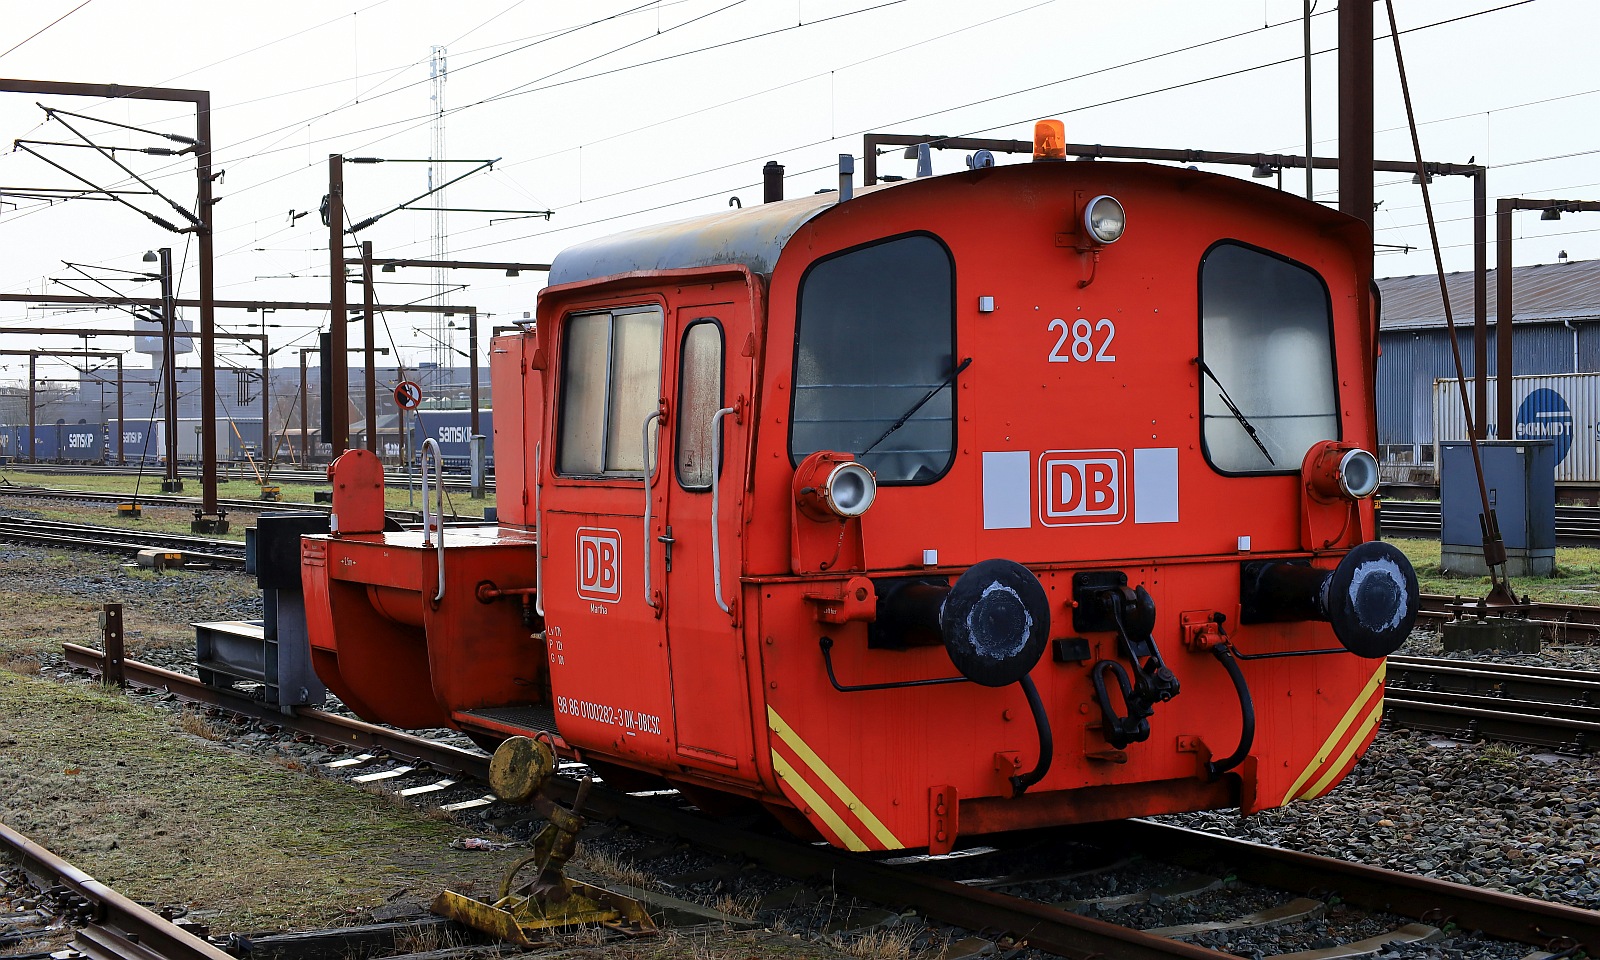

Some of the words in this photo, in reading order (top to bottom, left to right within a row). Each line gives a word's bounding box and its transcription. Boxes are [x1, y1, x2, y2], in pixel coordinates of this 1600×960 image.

[1047, 318, 1116, 363] 282
[1516, 422, 1572, 436] SCHMIDT
[1051, 463, 1115, 512] DB
[583, 540, 615, 588] DB
[590, 602, 608, 615] Martha
[557, 696, 568, 714] 98
[568, 698, 580, 717] 86
[580, 700, 624, 727] 0100282-3
[624, 709, 661, 735] DK-DBCSC
